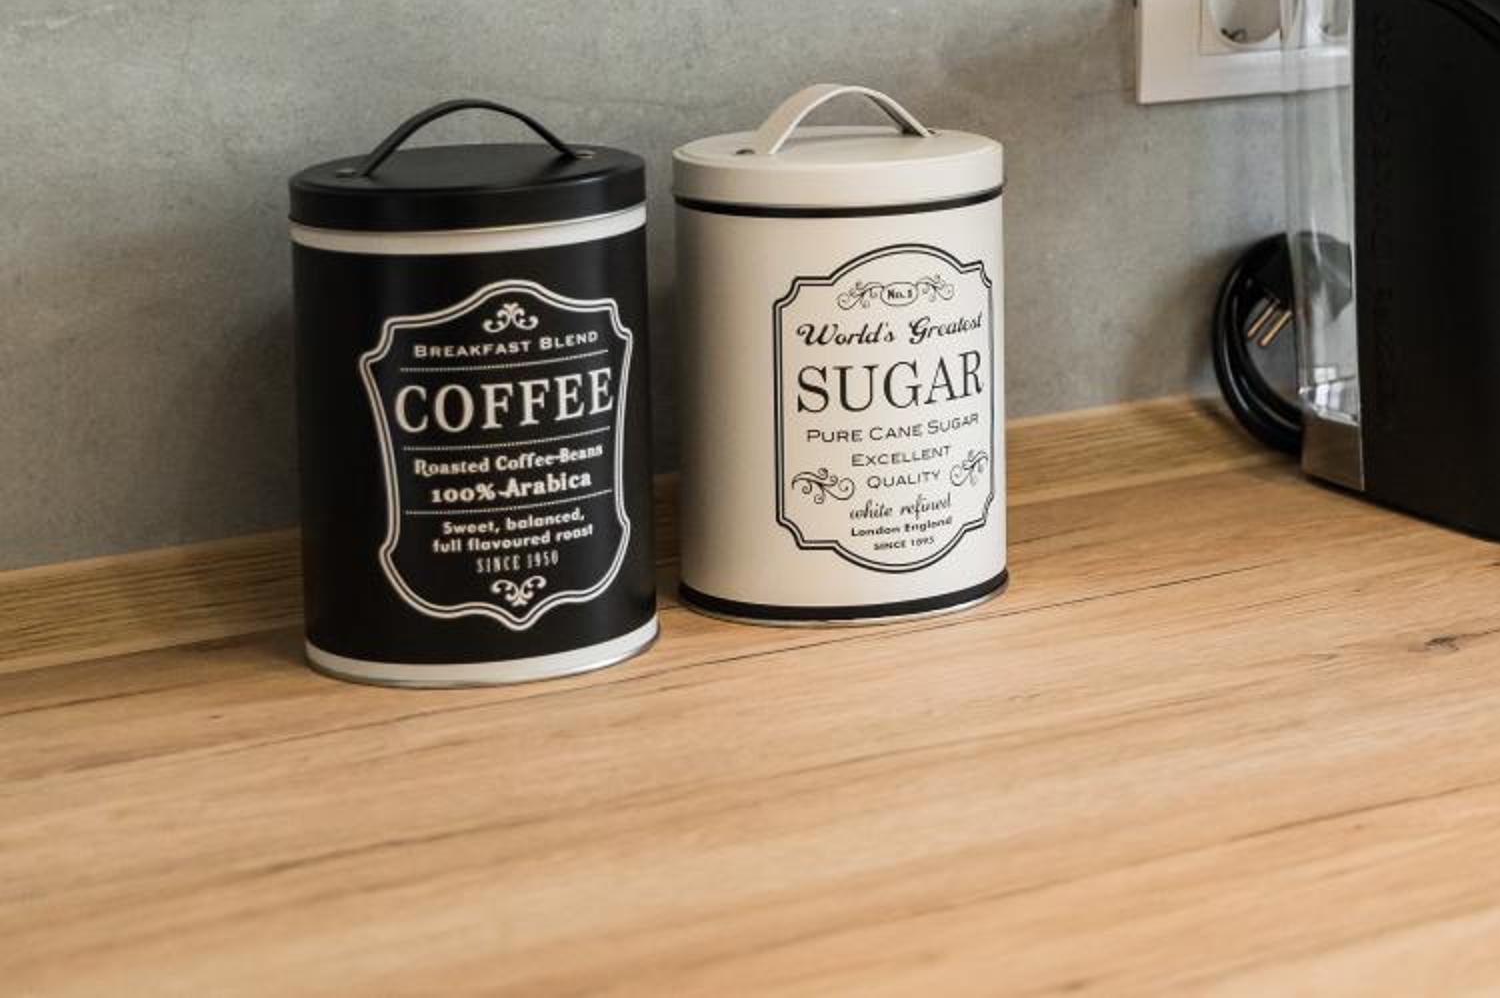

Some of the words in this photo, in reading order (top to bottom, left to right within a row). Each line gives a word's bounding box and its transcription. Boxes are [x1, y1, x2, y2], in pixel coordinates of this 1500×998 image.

[796, 322, 896, 346] World's
[908, 310, 983, 345] Greatest
[413, 339, 533, 359] BREAKFAST
[539, 330, 599, 351] BLEND
[797, 349, 984, 414] SUGAR
[394, 366, 615, 433] COFFEE
[806, 429, 863, 443] PURE
[869, 423, 923, 441] CANE
[927, 413, 979, 435] SUGAR
[414, 457, 491, 477] Roasted
[851, 445, 951, 467] EXCELLENT
[431, 484, 497, 503] 100%
[498, 472, 593, 499] Arabica
[867, 469, 940, 489] QUALITY
[443, 521, 500, 535] Sweet,
[506, 507, 585, 531] balanced,
[850, 498, 893, 520] white
[900, 492, 952, 521] refined
[432, 537, 462, 553] full
[467, 531, 551, 551] flavoured
[555, 524, 594, 542] roast
[851, 525, 901, 537] London
[904, 516, 953, 533] England
[874, 539, 906, 551] SINCE
[476, 554, 521, 573] SINCE
[527, 549, 559, 569] 1950
